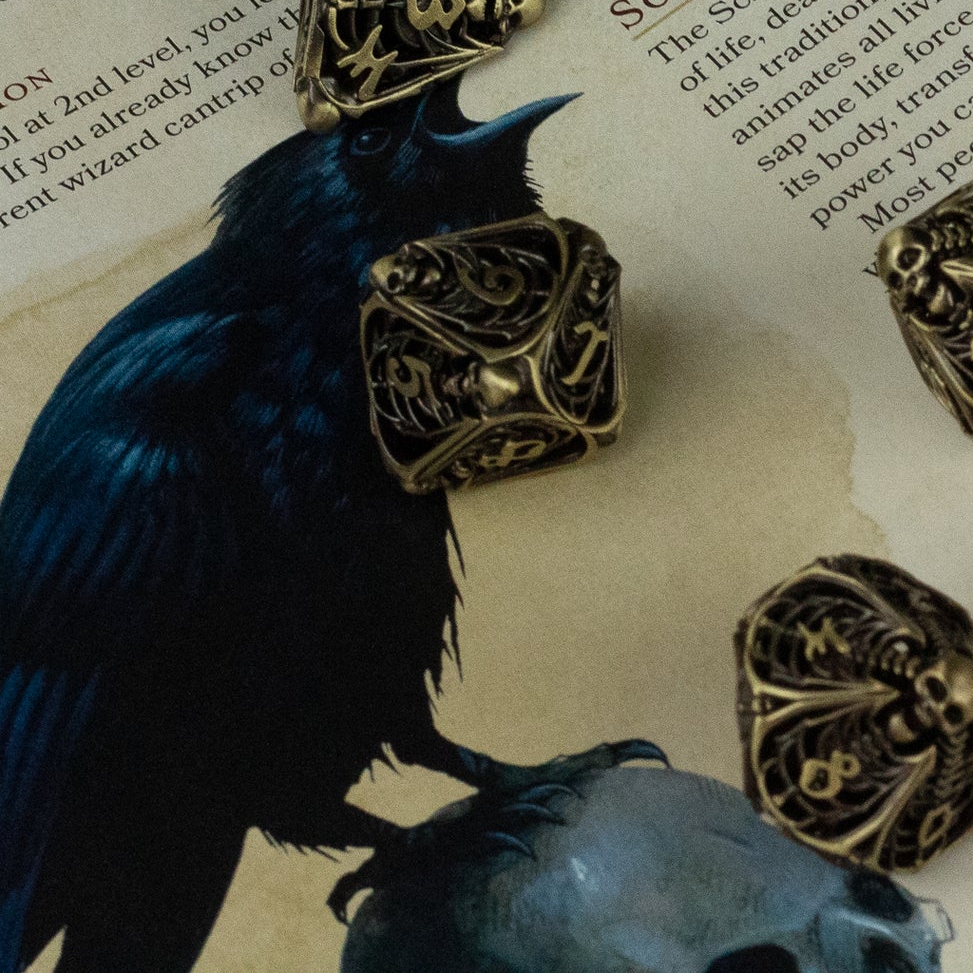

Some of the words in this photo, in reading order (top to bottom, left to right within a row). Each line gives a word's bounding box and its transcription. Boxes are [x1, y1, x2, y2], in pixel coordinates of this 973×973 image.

[647, 24, 709, 64] The
[680, 60, 708, 92] of
[705, 34, 765, 70] life,
[58, 128, 161, 192] wizard
[164, 75, 265, 137] cantrip
[779, 169, 821, 199] its
[816, 116, 898, 171] body,
